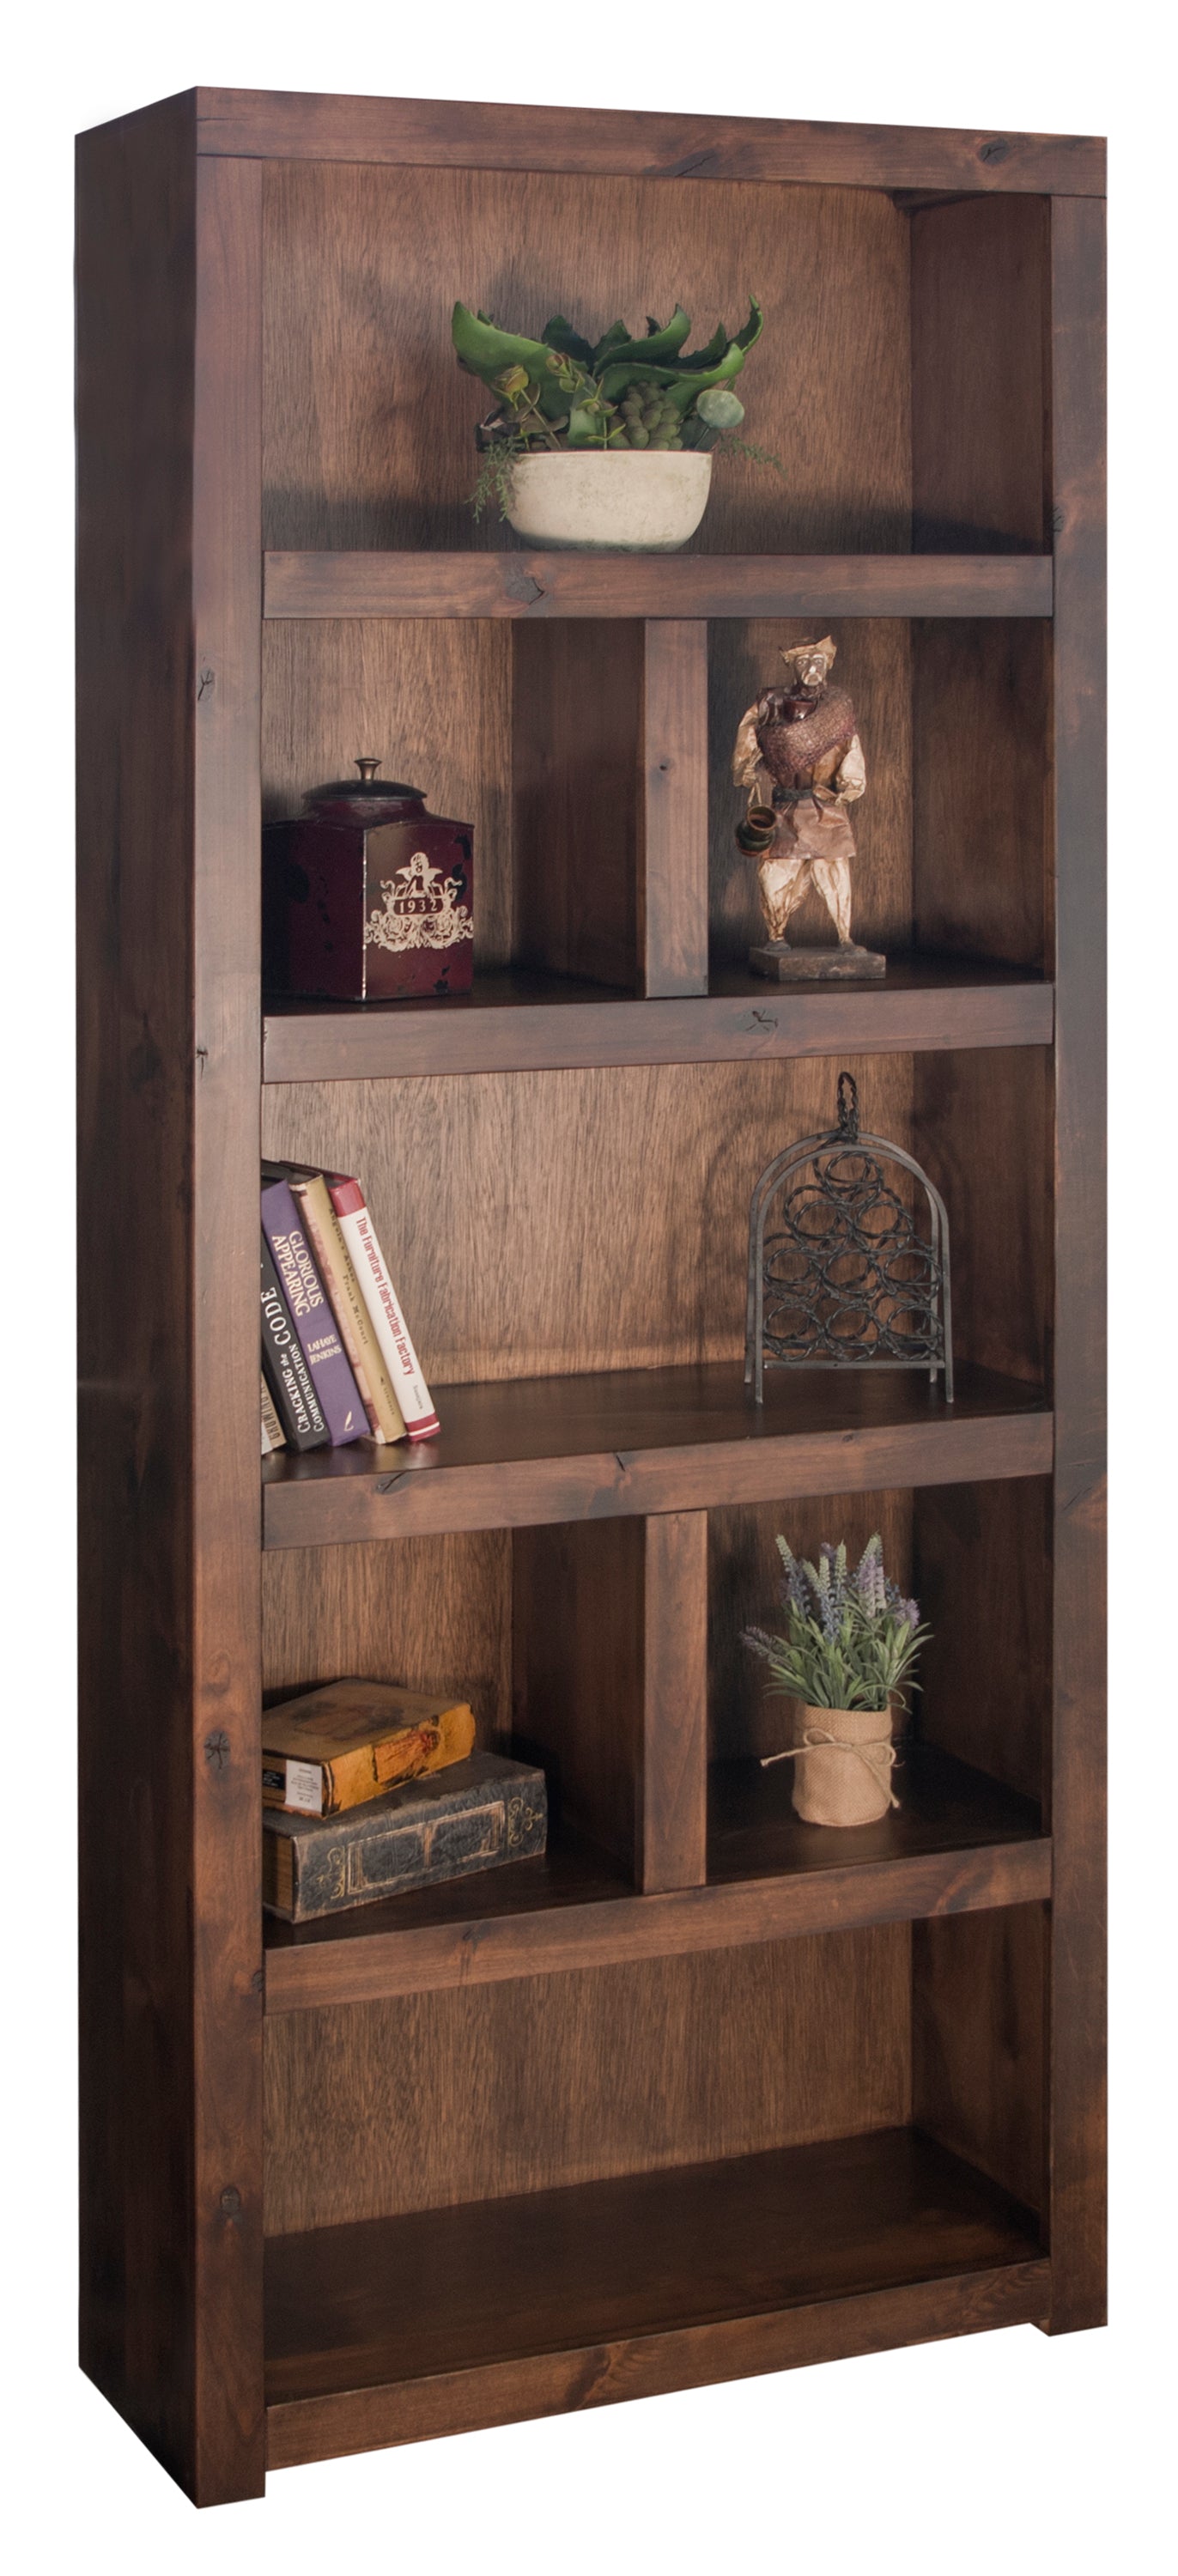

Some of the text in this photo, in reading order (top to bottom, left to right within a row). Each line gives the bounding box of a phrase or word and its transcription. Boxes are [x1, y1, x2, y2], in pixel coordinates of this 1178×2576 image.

[399, 899, 438, 914] 1932
[271, 1236, 310, 1316] APPEARING
[289, 1230, 324, 1307] GLORIOUS
[343, 1274, 355, 1302] Frank
[356, 1217, 415, 1376] The Furniture Fabrication Factory
[261, 1287, 291, 1345] CODE
[280, 1353, 311, 1433] CRACKING the
[288, 1344, 325, 1432] COMMUNICATION
[309, 1346, 342, 1364] JENKINS
